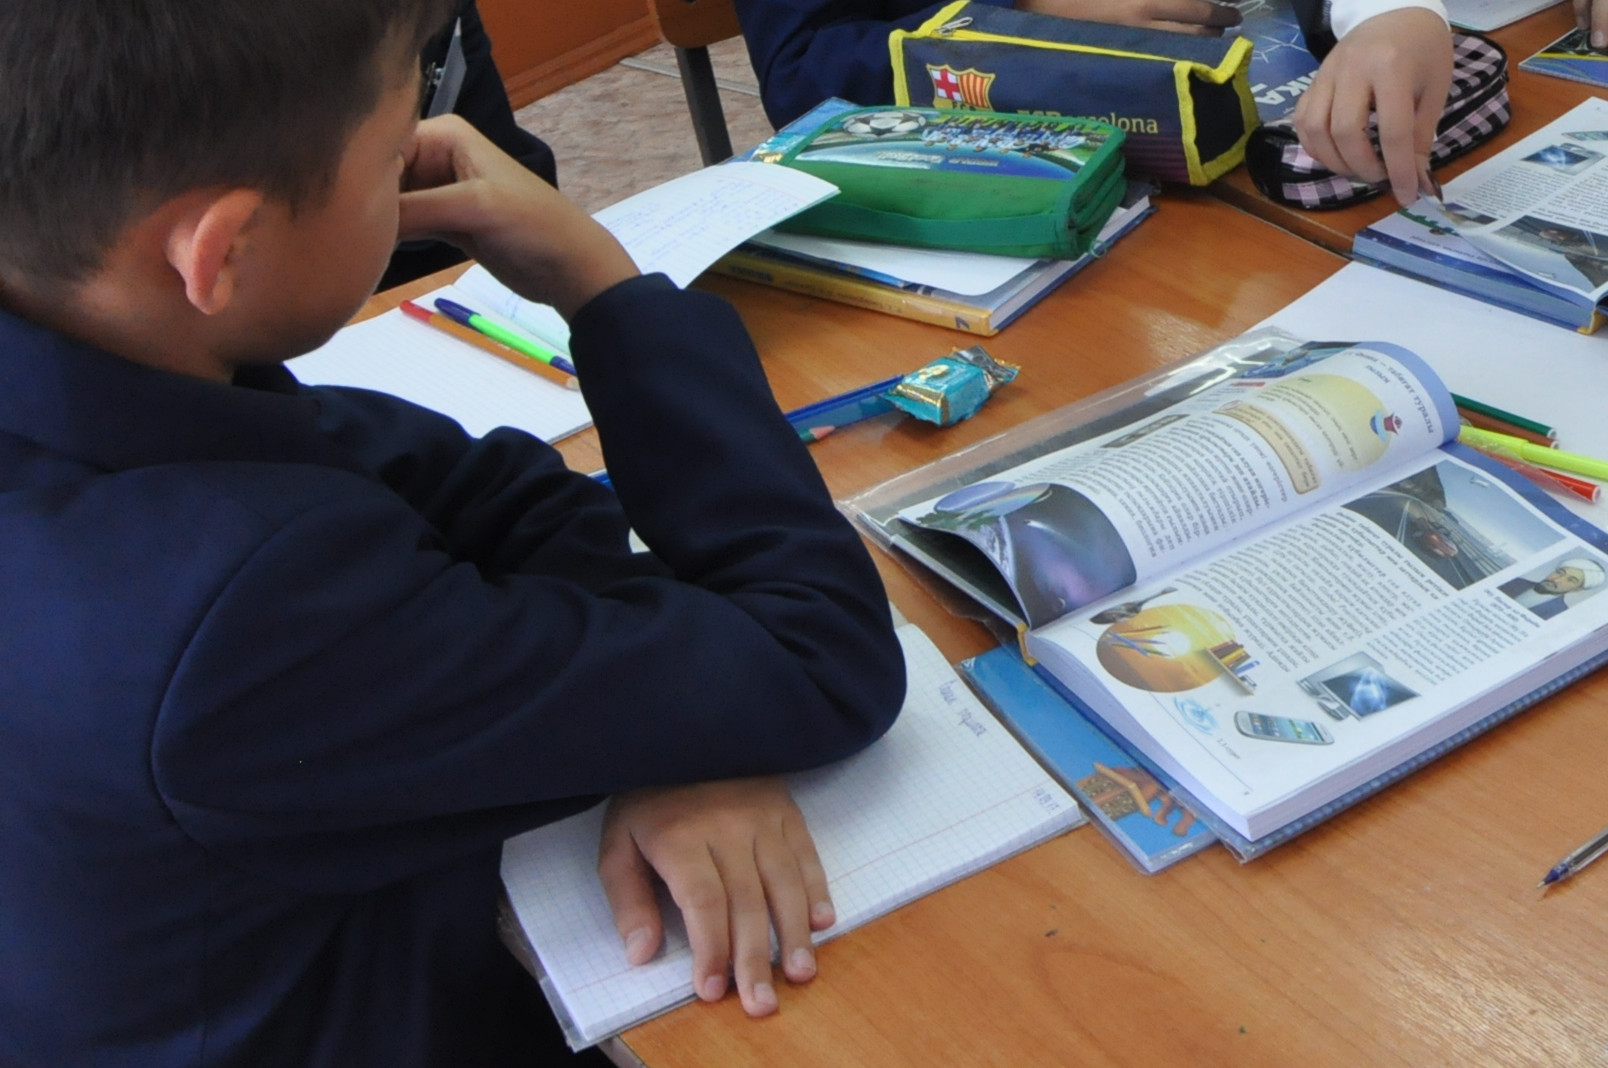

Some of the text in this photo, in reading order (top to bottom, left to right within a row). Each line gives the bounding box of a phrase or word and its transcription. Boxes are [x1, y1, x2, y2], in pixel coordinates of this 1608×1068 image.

[1409, 393, 1437, 436] туралы
[1224, 483, 1246, 521] отырып,
[1240, 492, 1256, 517] олар-
[1241, 474, 1262, 511] атайды.
[1132, 518, 1159, 559] биология
[1164, 512, 1186, 547] ғылым-
[1169, 502, 1194, 543] айналды.
[1189, 520, 1203, 540] бір-
[1153, 535, 1168, 555] фи-
[1162, 532, 1177, 552] деп
